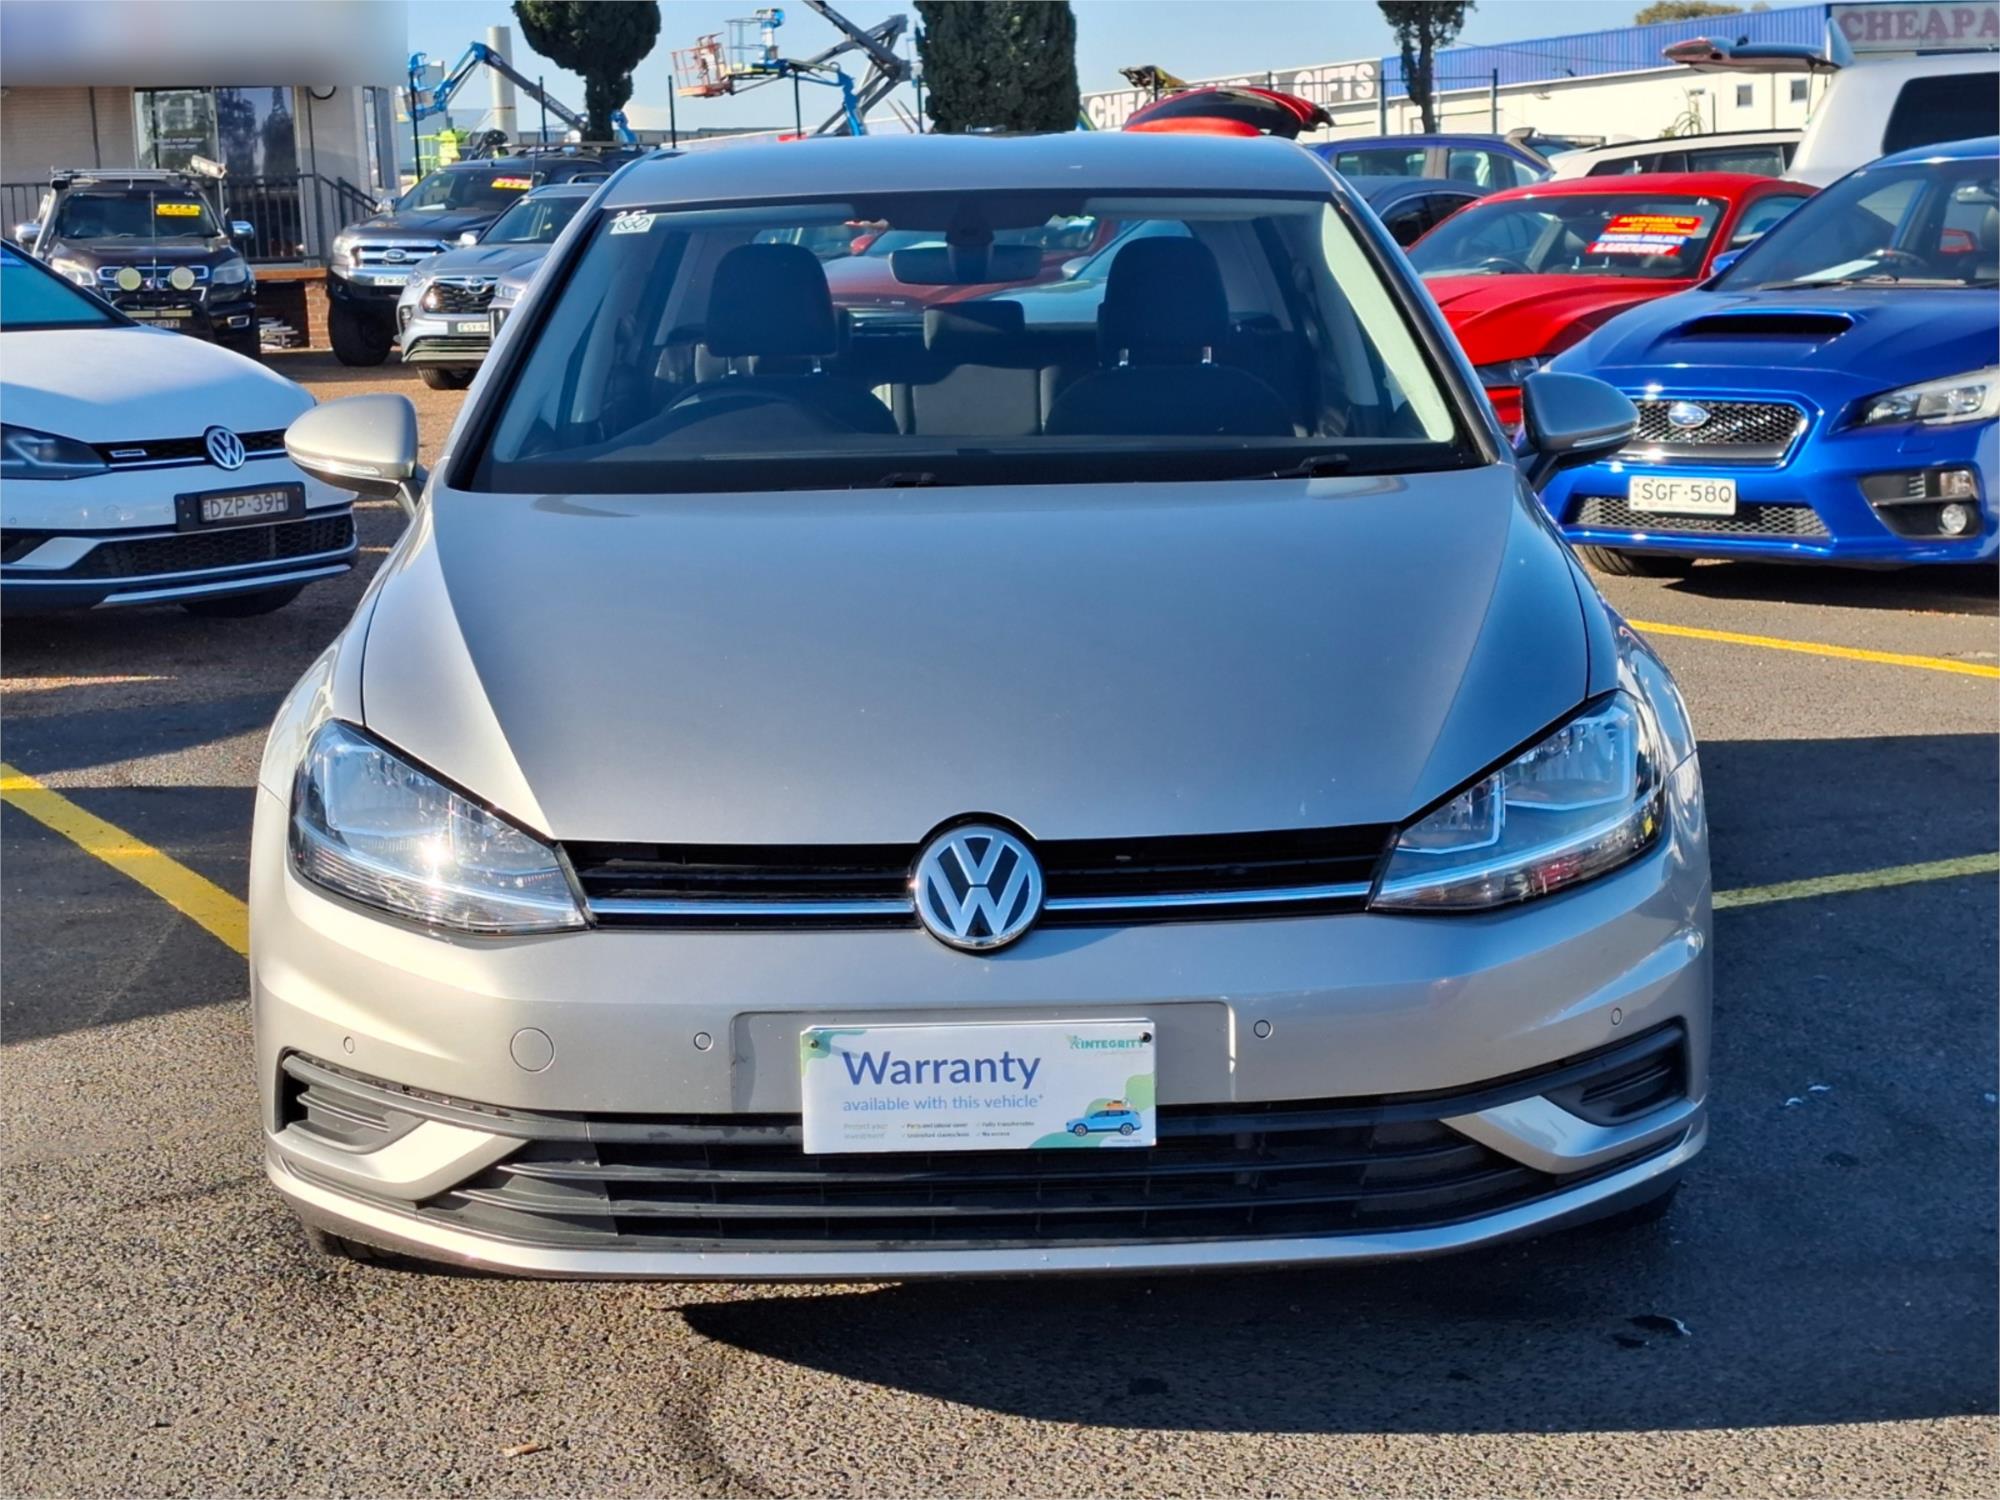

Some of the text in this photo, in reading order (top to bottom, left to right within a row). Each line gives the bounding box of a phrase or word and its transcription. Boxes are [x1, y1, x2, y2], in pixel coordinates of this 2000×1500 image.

[1293, 62, 1374, 104] GIFTS
[842, 1050, 1041, 1090] Warranty
[843, 1097, 910, 1112] available
[915, 1096, 947, 1110] with
[952, 1095, 980, 1109] this
